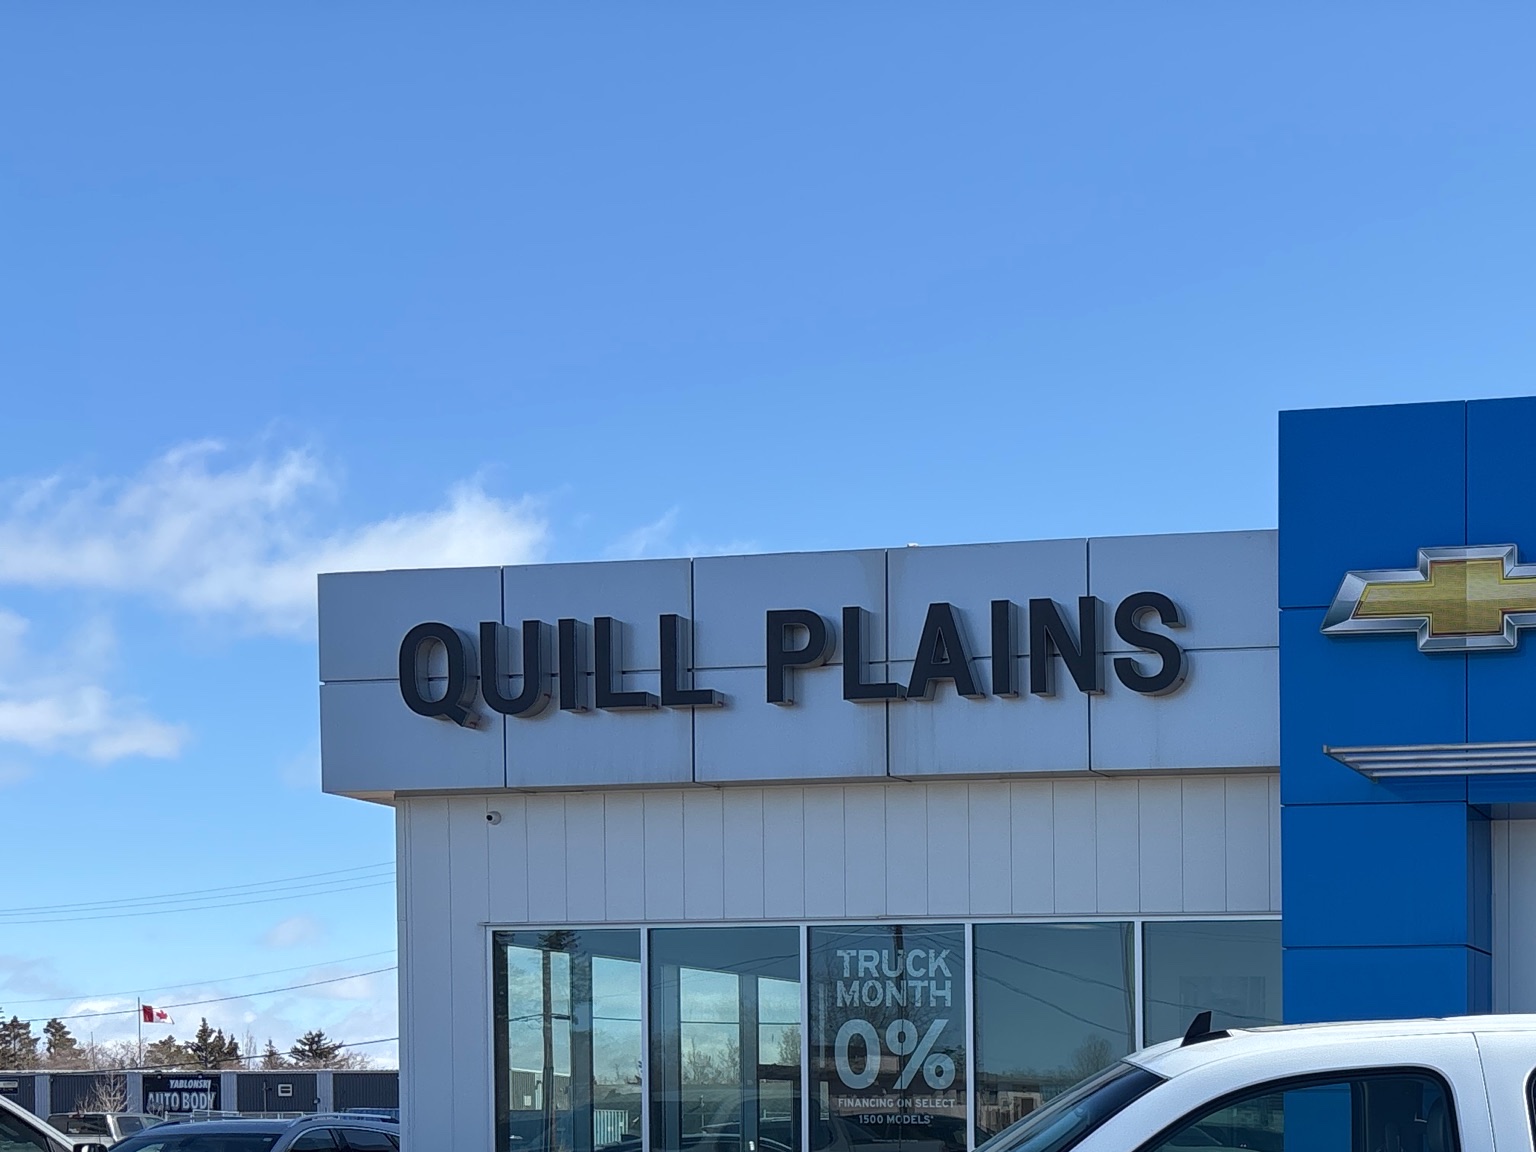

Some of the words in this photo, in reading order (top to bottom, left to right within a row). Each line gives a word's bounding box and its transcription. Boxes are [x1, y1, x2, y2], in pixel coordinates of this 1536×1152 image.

[399, 613, 727, 730] QUILL
[766, 591, 1188, 705] PLAINS
[836, 949, 952, 978] TRUCK
[836, 980, 952, 1008] MONTH
[834, 1018, 956, 1090] 0%
[148, 1091, 180, 1109] AUTO
[182, 1091, 217, 1109] BODY
[838, 1098, 894, 1108] FINANCING
[897, 1098, 910, 1108] ON
[915, 1098, 955, 1108] SELECT
[859, 1115, 884, 1124] 1500
